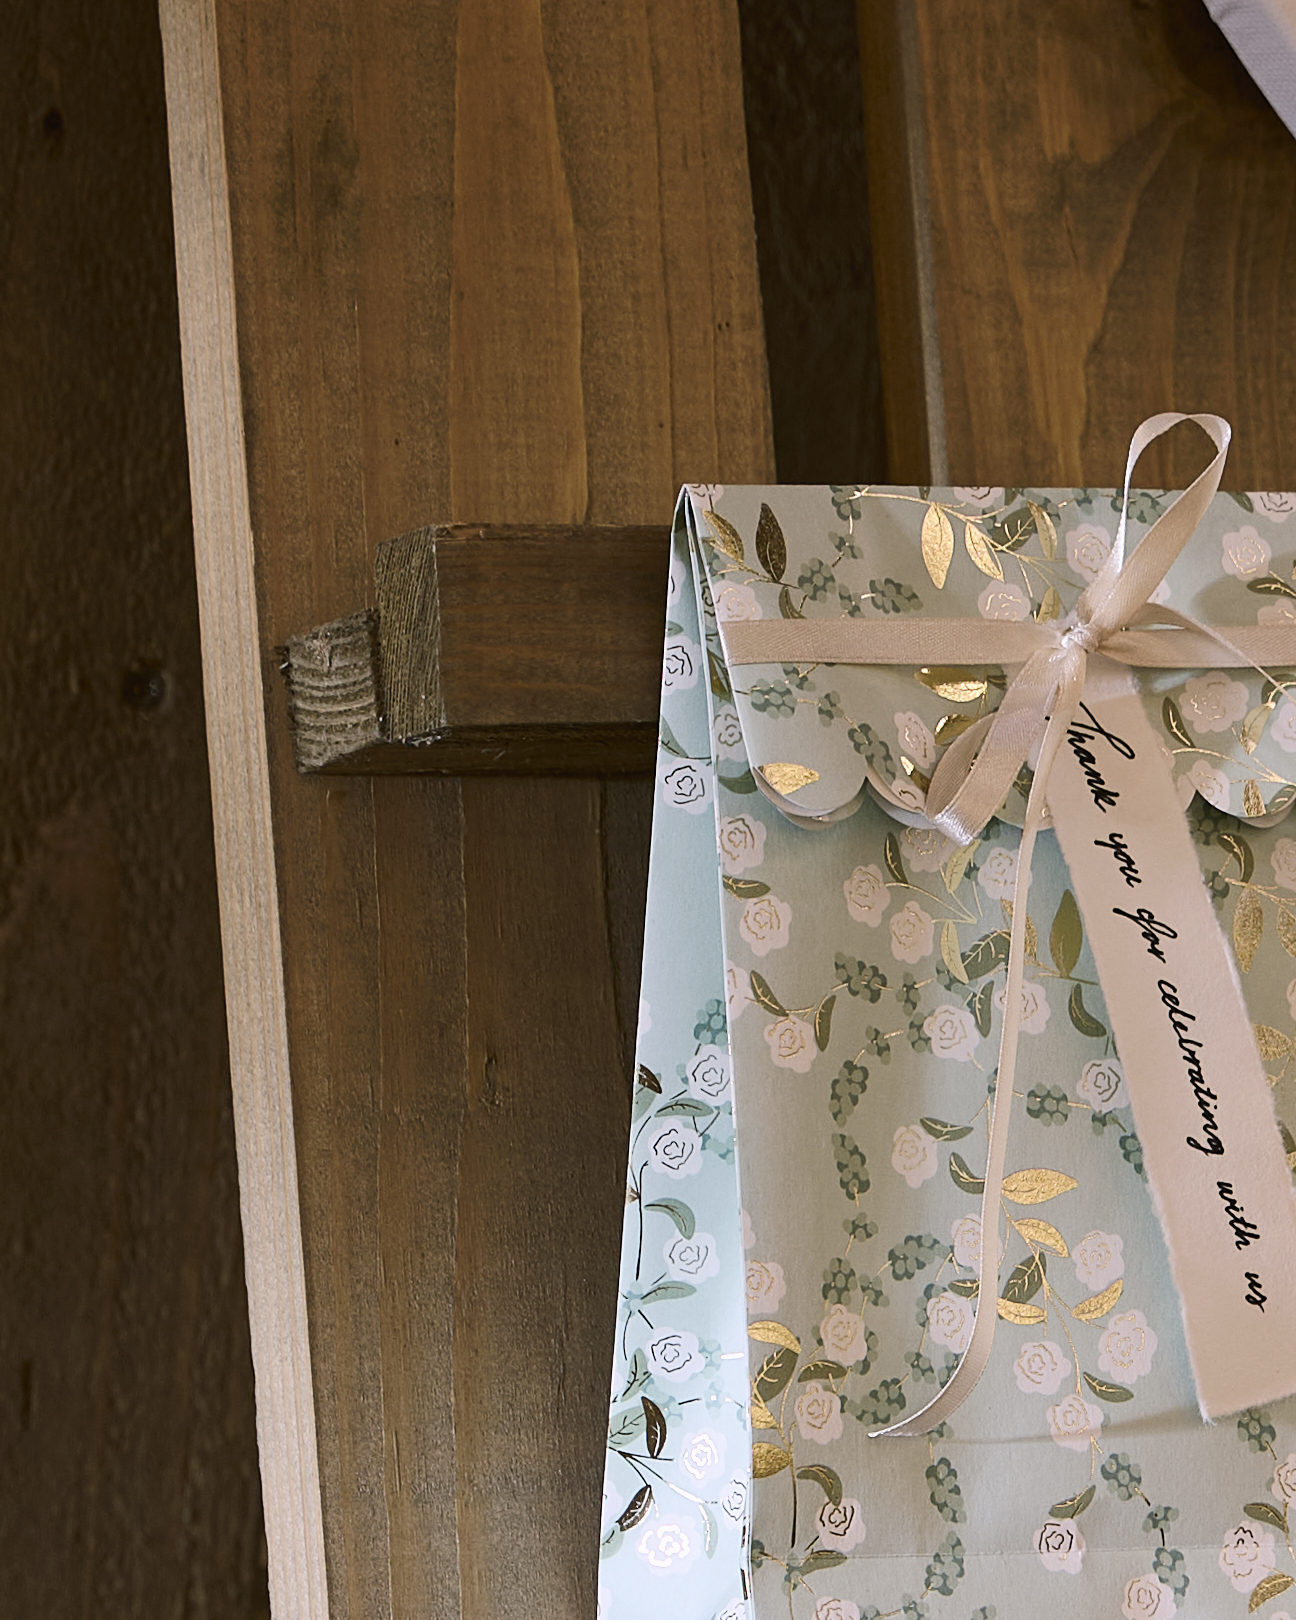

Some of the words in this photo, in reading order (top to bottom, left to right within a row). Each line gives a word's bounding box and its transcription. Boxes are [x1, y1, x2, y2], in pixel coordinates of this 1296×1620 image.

[1045, 700, 1136, 814] Thank
[1093, 830, 1142, 889] you
[1112, 907, 1178, 964] for
[1157, 979, 1225, 1157] celebrating
[1216, 1180, 1256, 1251] with
[1244, 1271, 1268, 1314] us
